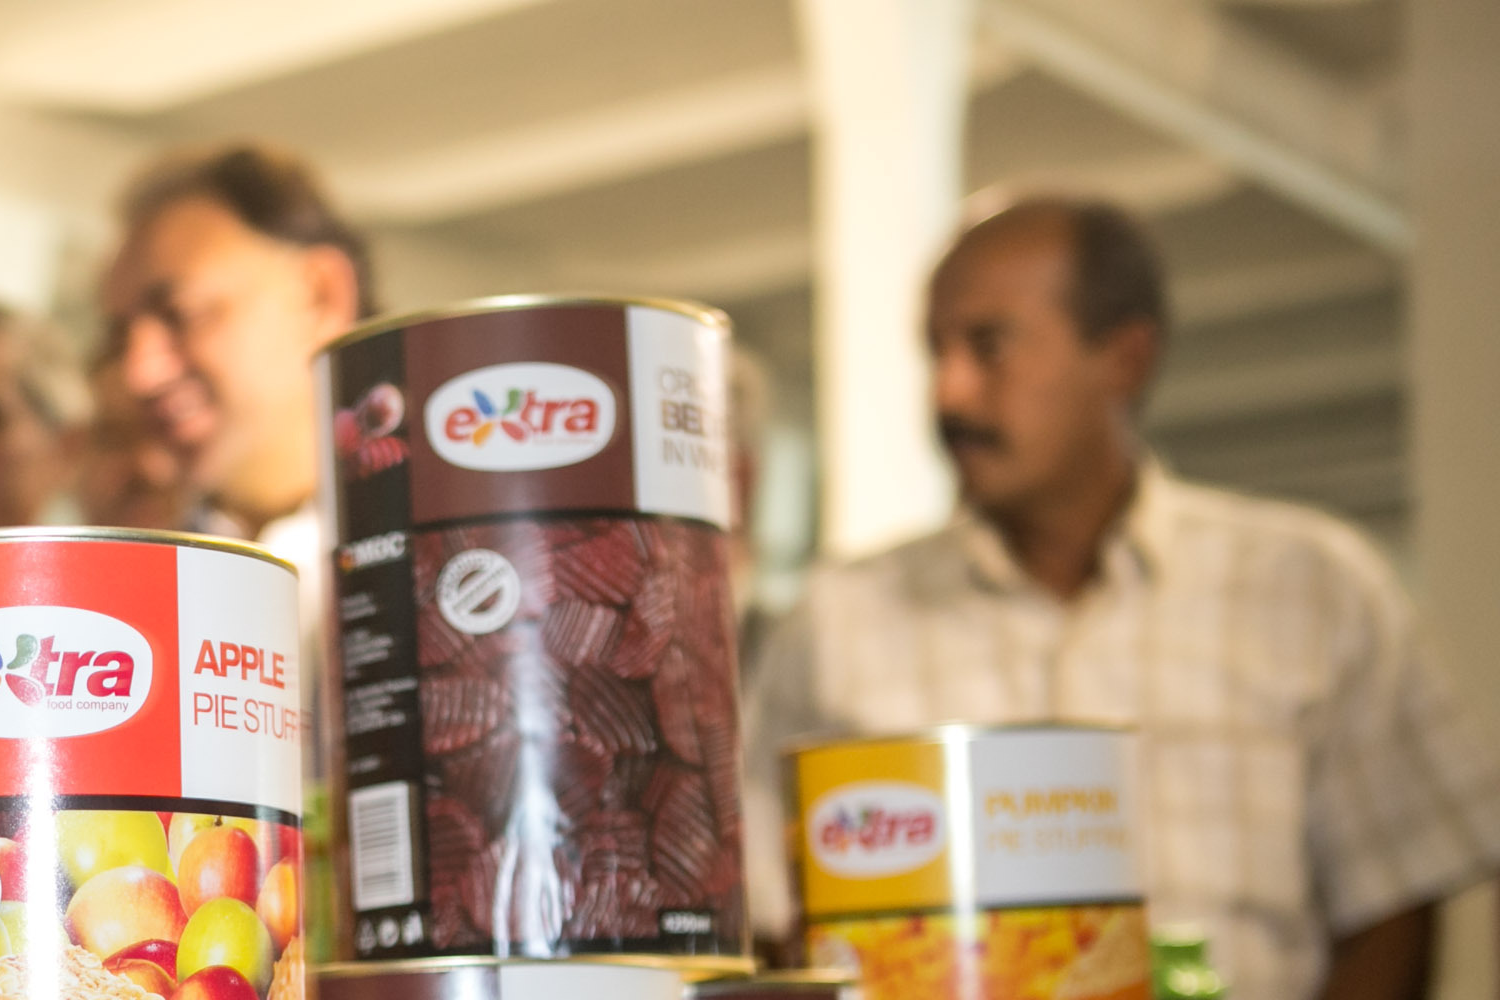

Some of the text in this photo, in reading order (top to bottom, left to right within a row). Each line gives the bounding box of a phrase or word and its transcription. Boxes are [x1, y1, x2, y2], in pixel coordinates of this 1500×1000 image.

[194, 639, 285, 690] APPLE
[47, 699, 129, 712] food company
[194, 692, 238, 730] PIE
